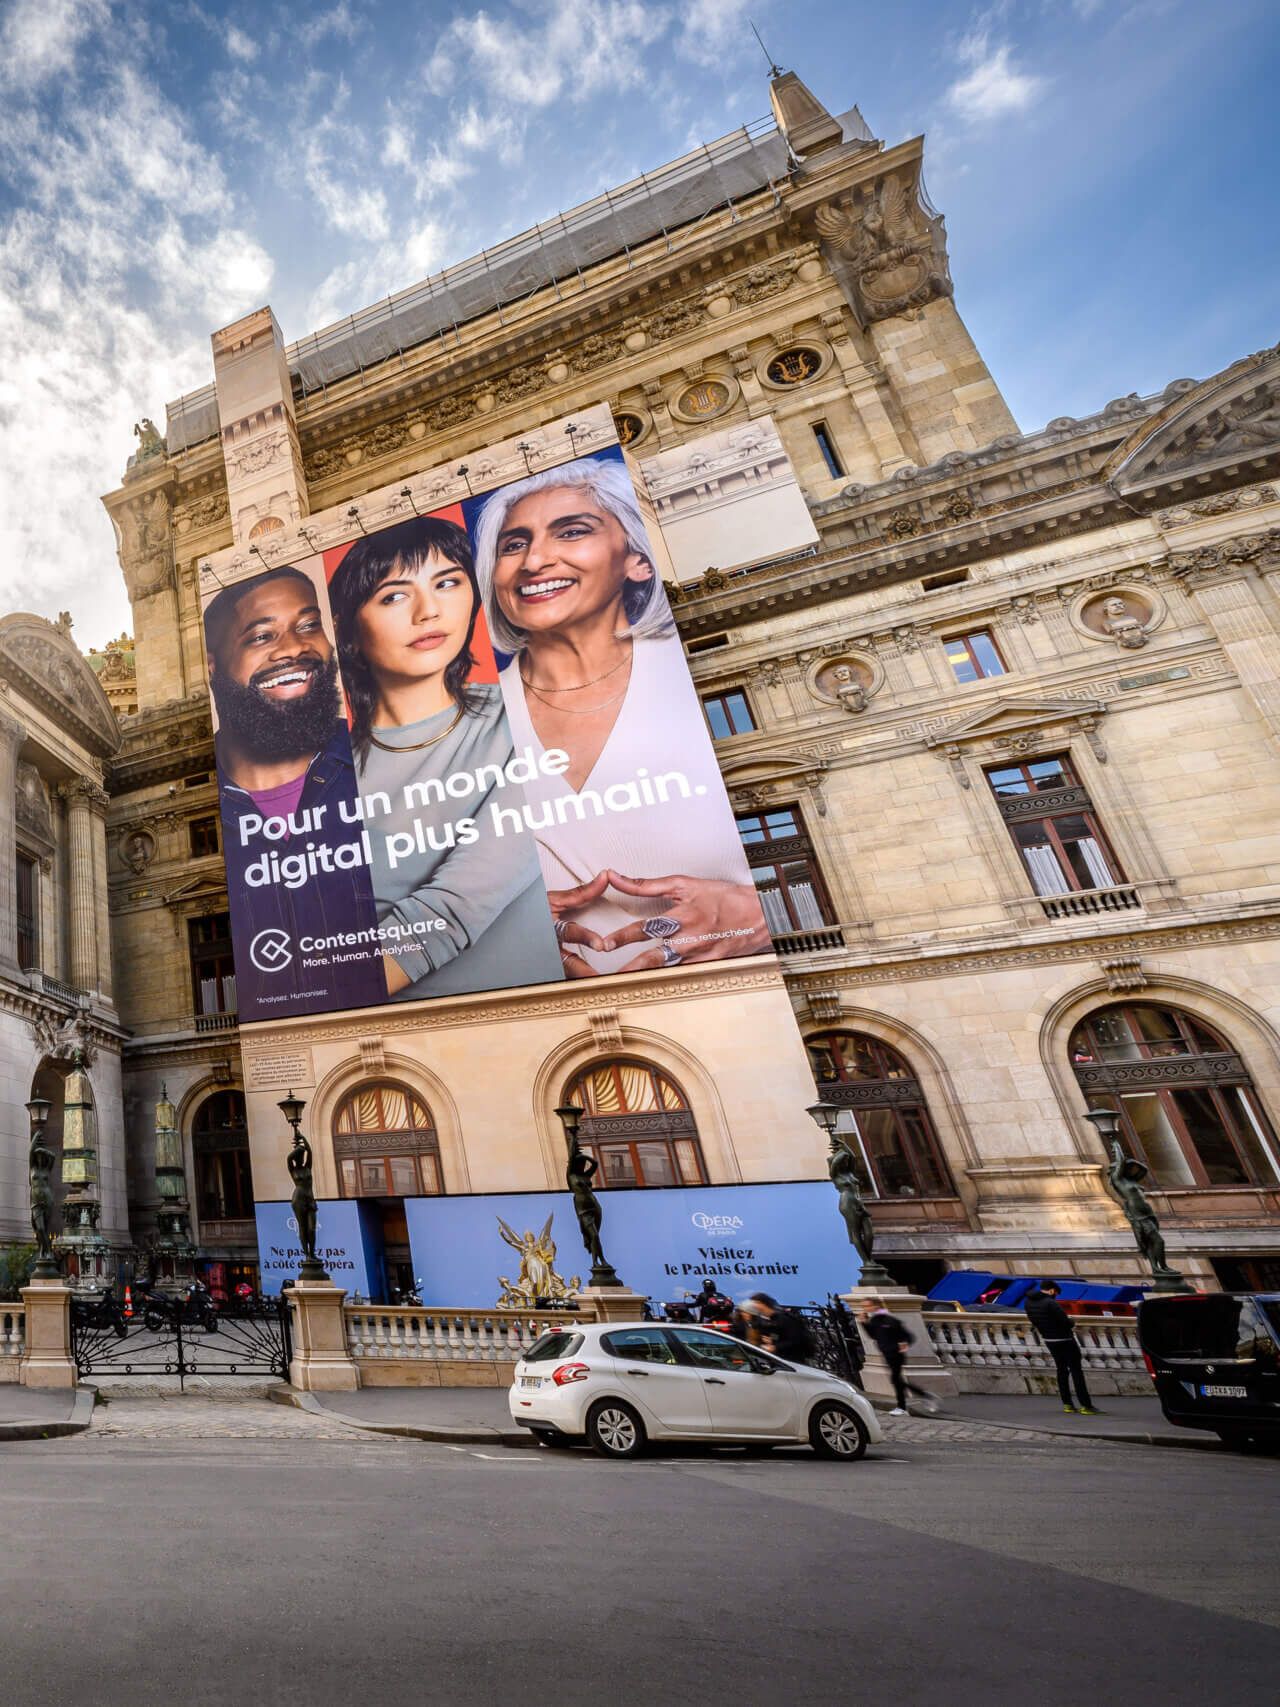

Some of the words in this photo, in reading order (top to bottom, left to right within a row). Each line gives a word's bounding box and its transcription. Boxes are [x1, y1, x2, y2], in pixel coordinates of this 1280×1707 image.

[238, 804, 327, 847] Pour
[338, 791, 392, 824] un
[403, 746, 570, 809] monde
[244, 830, 373, 889] digital
[385, 816, 480, 869] plus
[489, 768, 707, 837] humain.
[299, 917, 447, 952] Contentsquare
[302, 956, 330, 968] More.
[332, 951, 371, 964] Human.
[270, 1246, 284, 1257] Ne
[325, 1247, 346, 1258] pas
[697, 1247, 755, 1259] Visitez
[664, 1263, 679, 1275] le
[681, 1262, 732, 1275] Palais
[734, 1261, 799, 1275] Garnier
